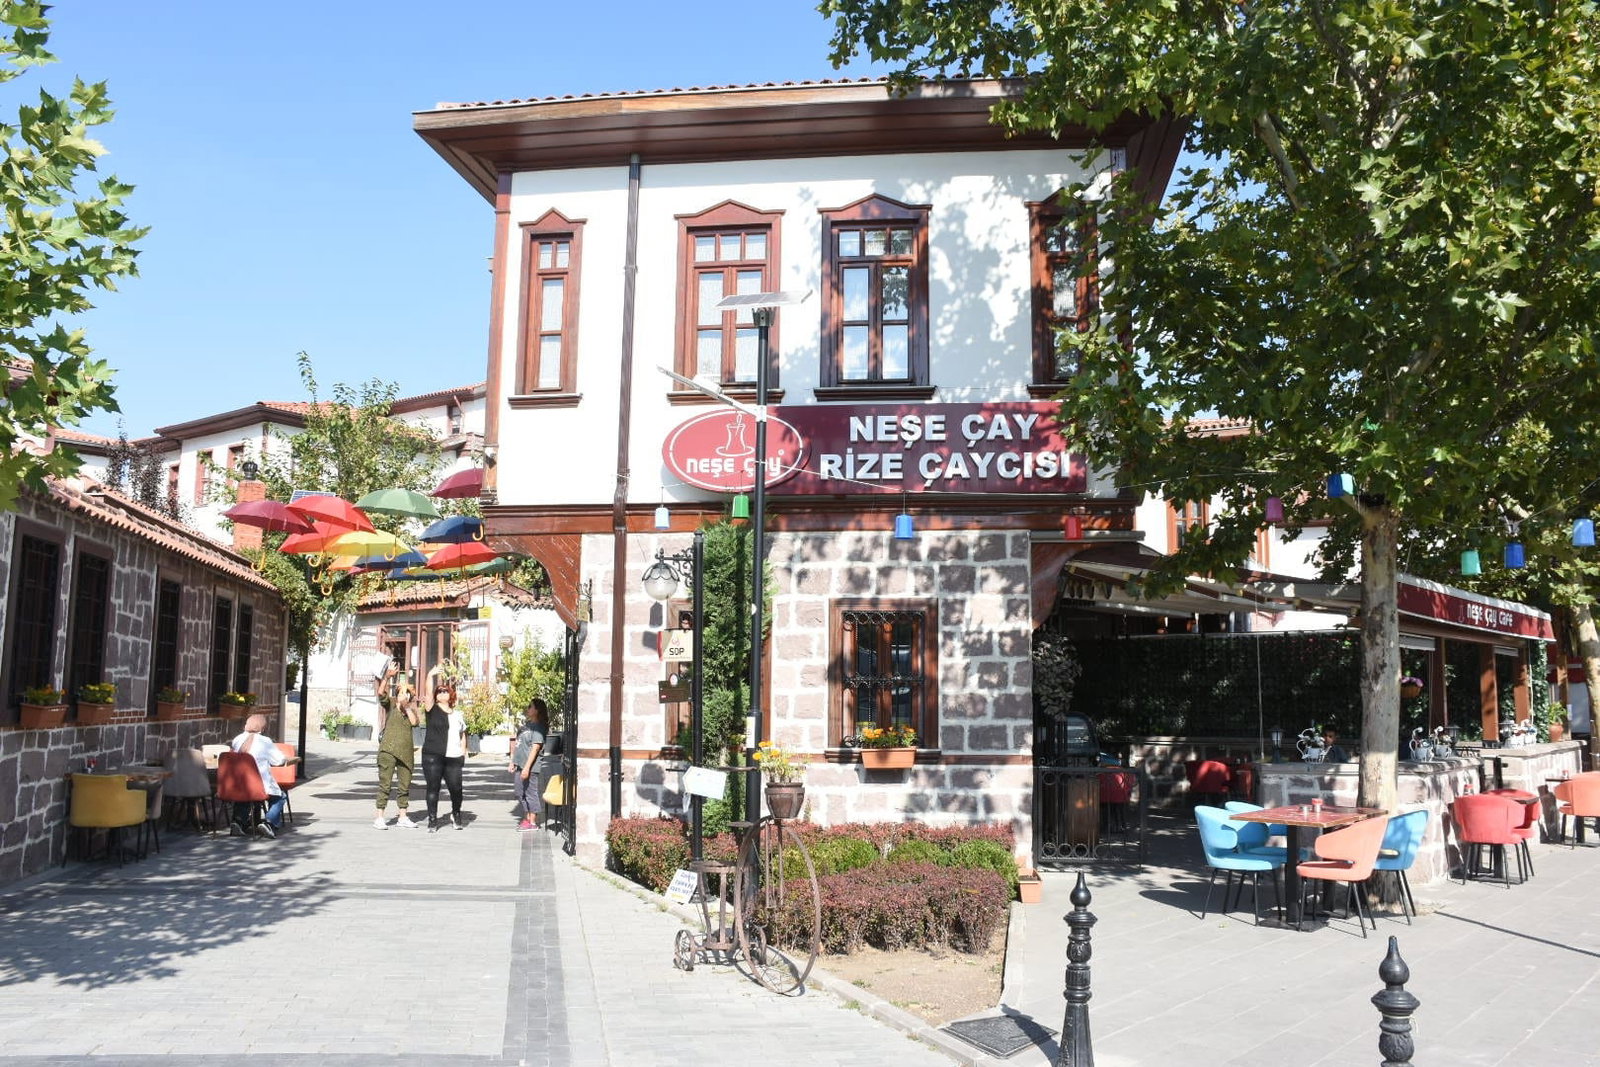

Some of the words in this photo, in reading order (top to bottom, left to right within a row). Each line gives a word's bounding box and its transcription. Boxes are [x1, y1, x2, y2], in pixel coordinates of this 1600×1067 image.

[850, 414, 946, 449] NEŞE
[961, 413, 1039, 449] ÇAY
[820, 448, 903, 480] RİZE
[918, 451, 1071, 488] ÇAYCISI
